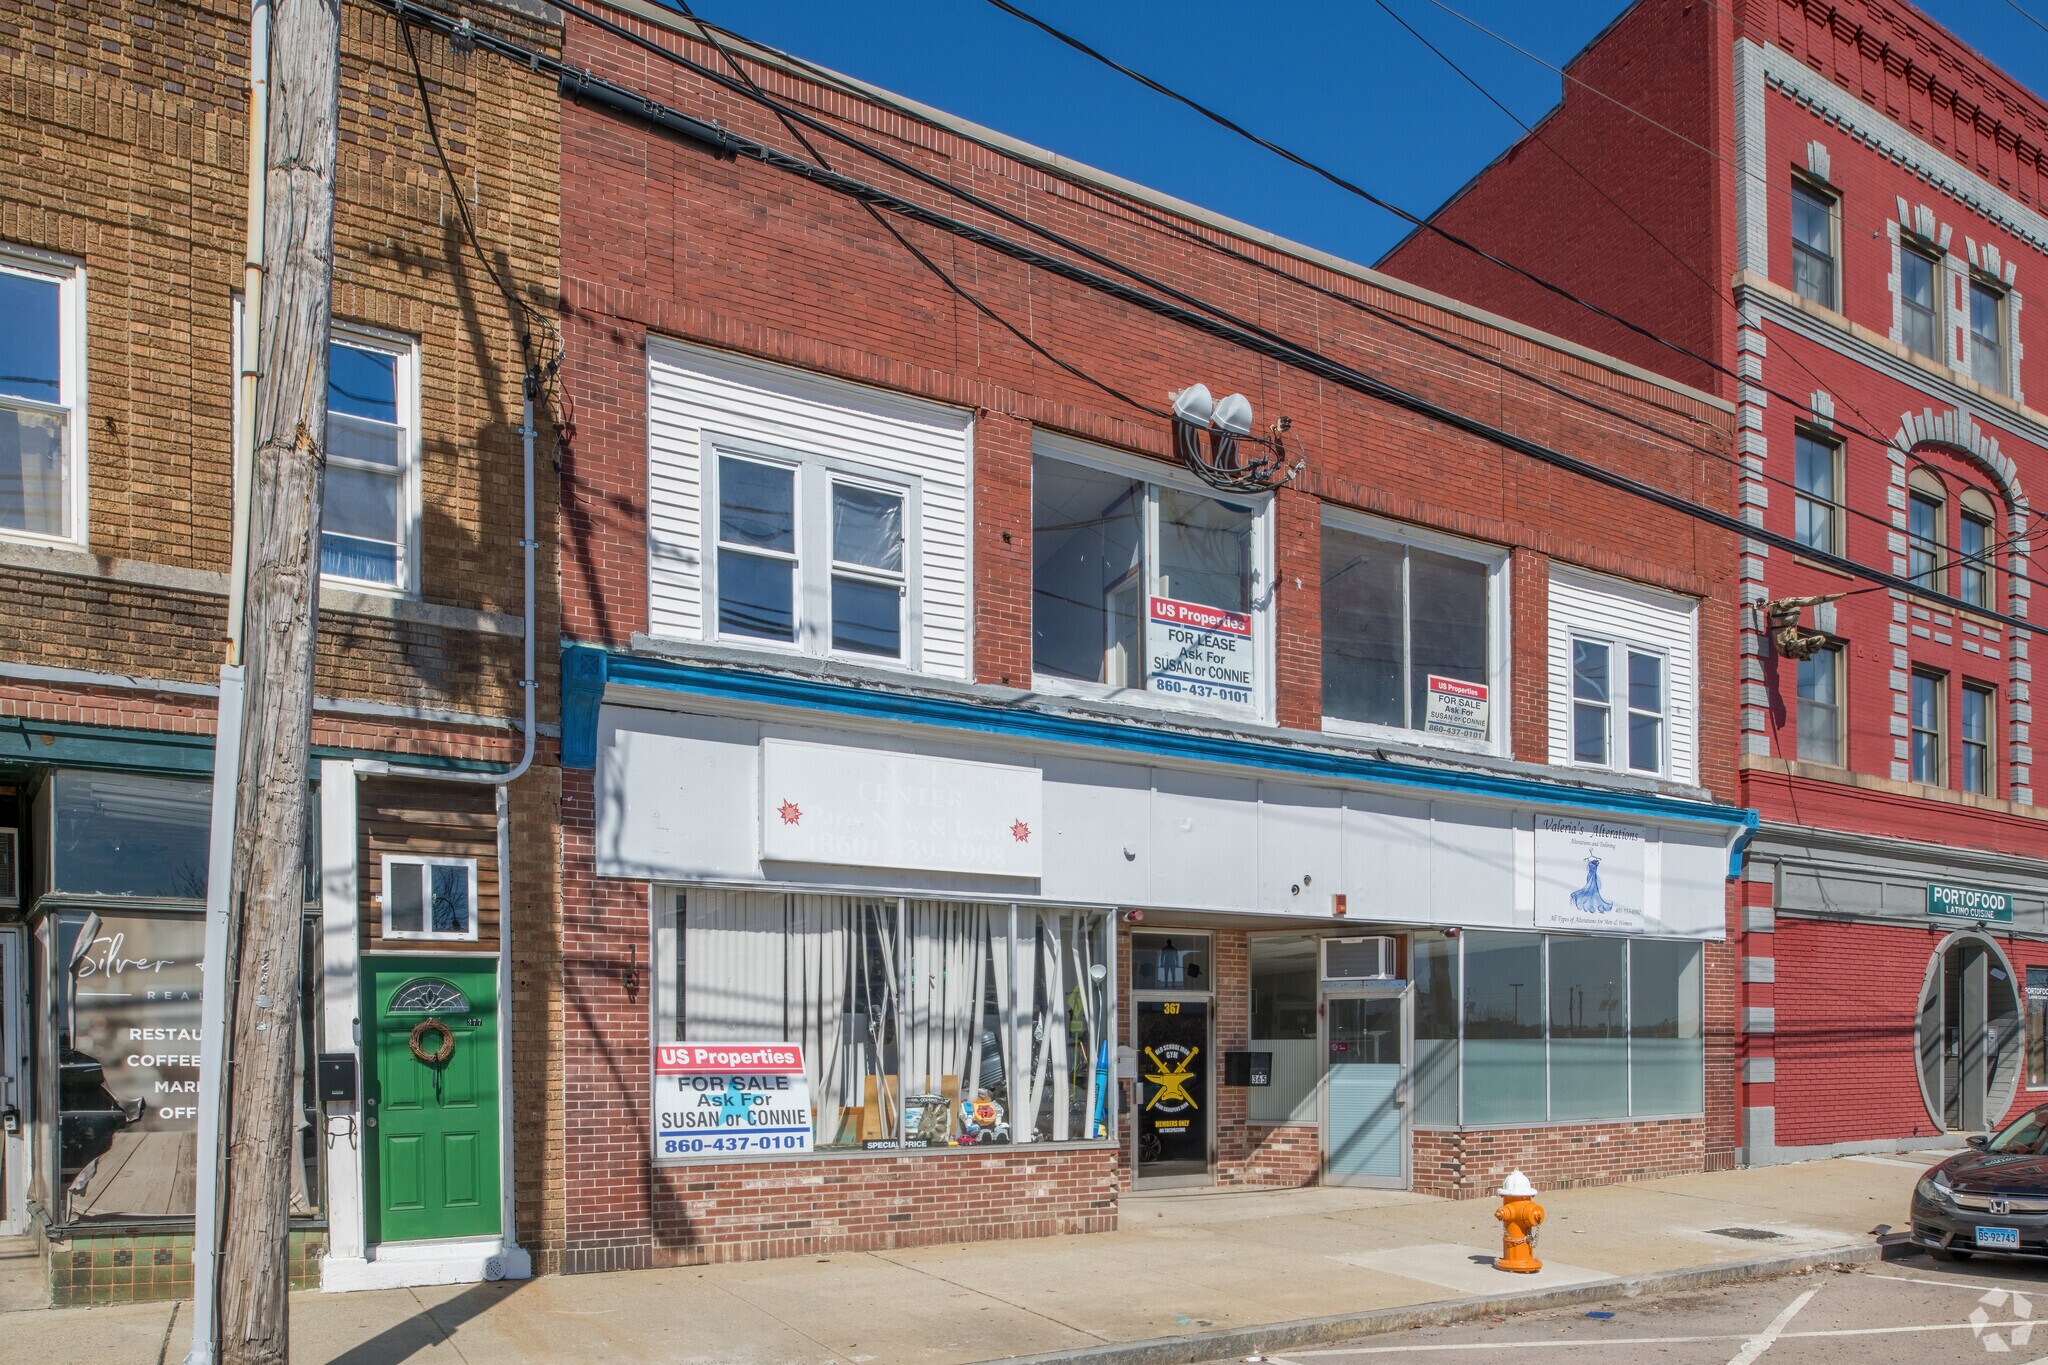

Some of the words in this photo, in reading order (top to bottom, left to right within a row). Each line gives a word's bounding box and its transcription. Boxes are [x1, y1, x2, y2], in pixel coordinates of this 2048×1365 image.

[1156, 602, 1176, 617] US
[1179, 607, 1246, 630] Properties
[1168, 629, 1194, 645] FOR
[1197, 634, 1236, 652] LEASE
[1179, 647, 1203, 661] Ask
[1206, 651, 1226, 665] For
[1154, 656, 1192, 675] SUSAN
[1195, 666, 1206, 677] or
[1208, 666, 1250, 684] CONNIE
[1156, 679, 1249, 703] 860-437-0101
[1438, 682, 1447, 690] US
[1448, 684, 1478, 696] Properties
[1438, 695, 1457, 705] FOR
[1458, 699, 1481, 710] SALE
[1445, 705, 1459, 714] Ask
[1461, 708, 1474, 717] For
[1430, 711, 1453, 721] SUSAN
[1462, 717, 1486, 727] CONNIE
[1428, 724, 1482, 739] 860-437-0101
[1543, 818, 1585, 835] Valeria's
[1590, 823, 1639, 841] Alterations
[1934, 887, 2005, 910] PORTOFOOD
[1946, 905, 1969, 916] LATINO
[1970, 908, 1995, 919] CUISINE
[78, 933, 175, 978] Silver
[1164, 1003, 1180, 1014] 367
[661, 1049, 690, 1065] US
[695, 1048, 795, 1067] Properties
[1166, 1051, 1178, 1059] GYM
[678, 1076, 725, 1091] FOR
[732, 1076, 789, 1091] SALE
[1252, 1075, 1267, 1084] 365
[154, 1081, 200, 1094] MAR
[697, 1094, 734, 1107] Ask
[741, 1093, 772, 1106] For
[159, 1107, 199, 1120] OFF
[661, 1110, 720, 1129] SUSAN
[725, 1114, 742, 1126] or
[747, 1109, 806, 1126] CONNIE
[1155, 1120, 1178, 1128] MEMBERS
[665, 1135, 805, 1153] 860-437-0101
[867, 1141, 900, 1149] SPECIAL
[905, 1140, 927, 1148] PRICE
